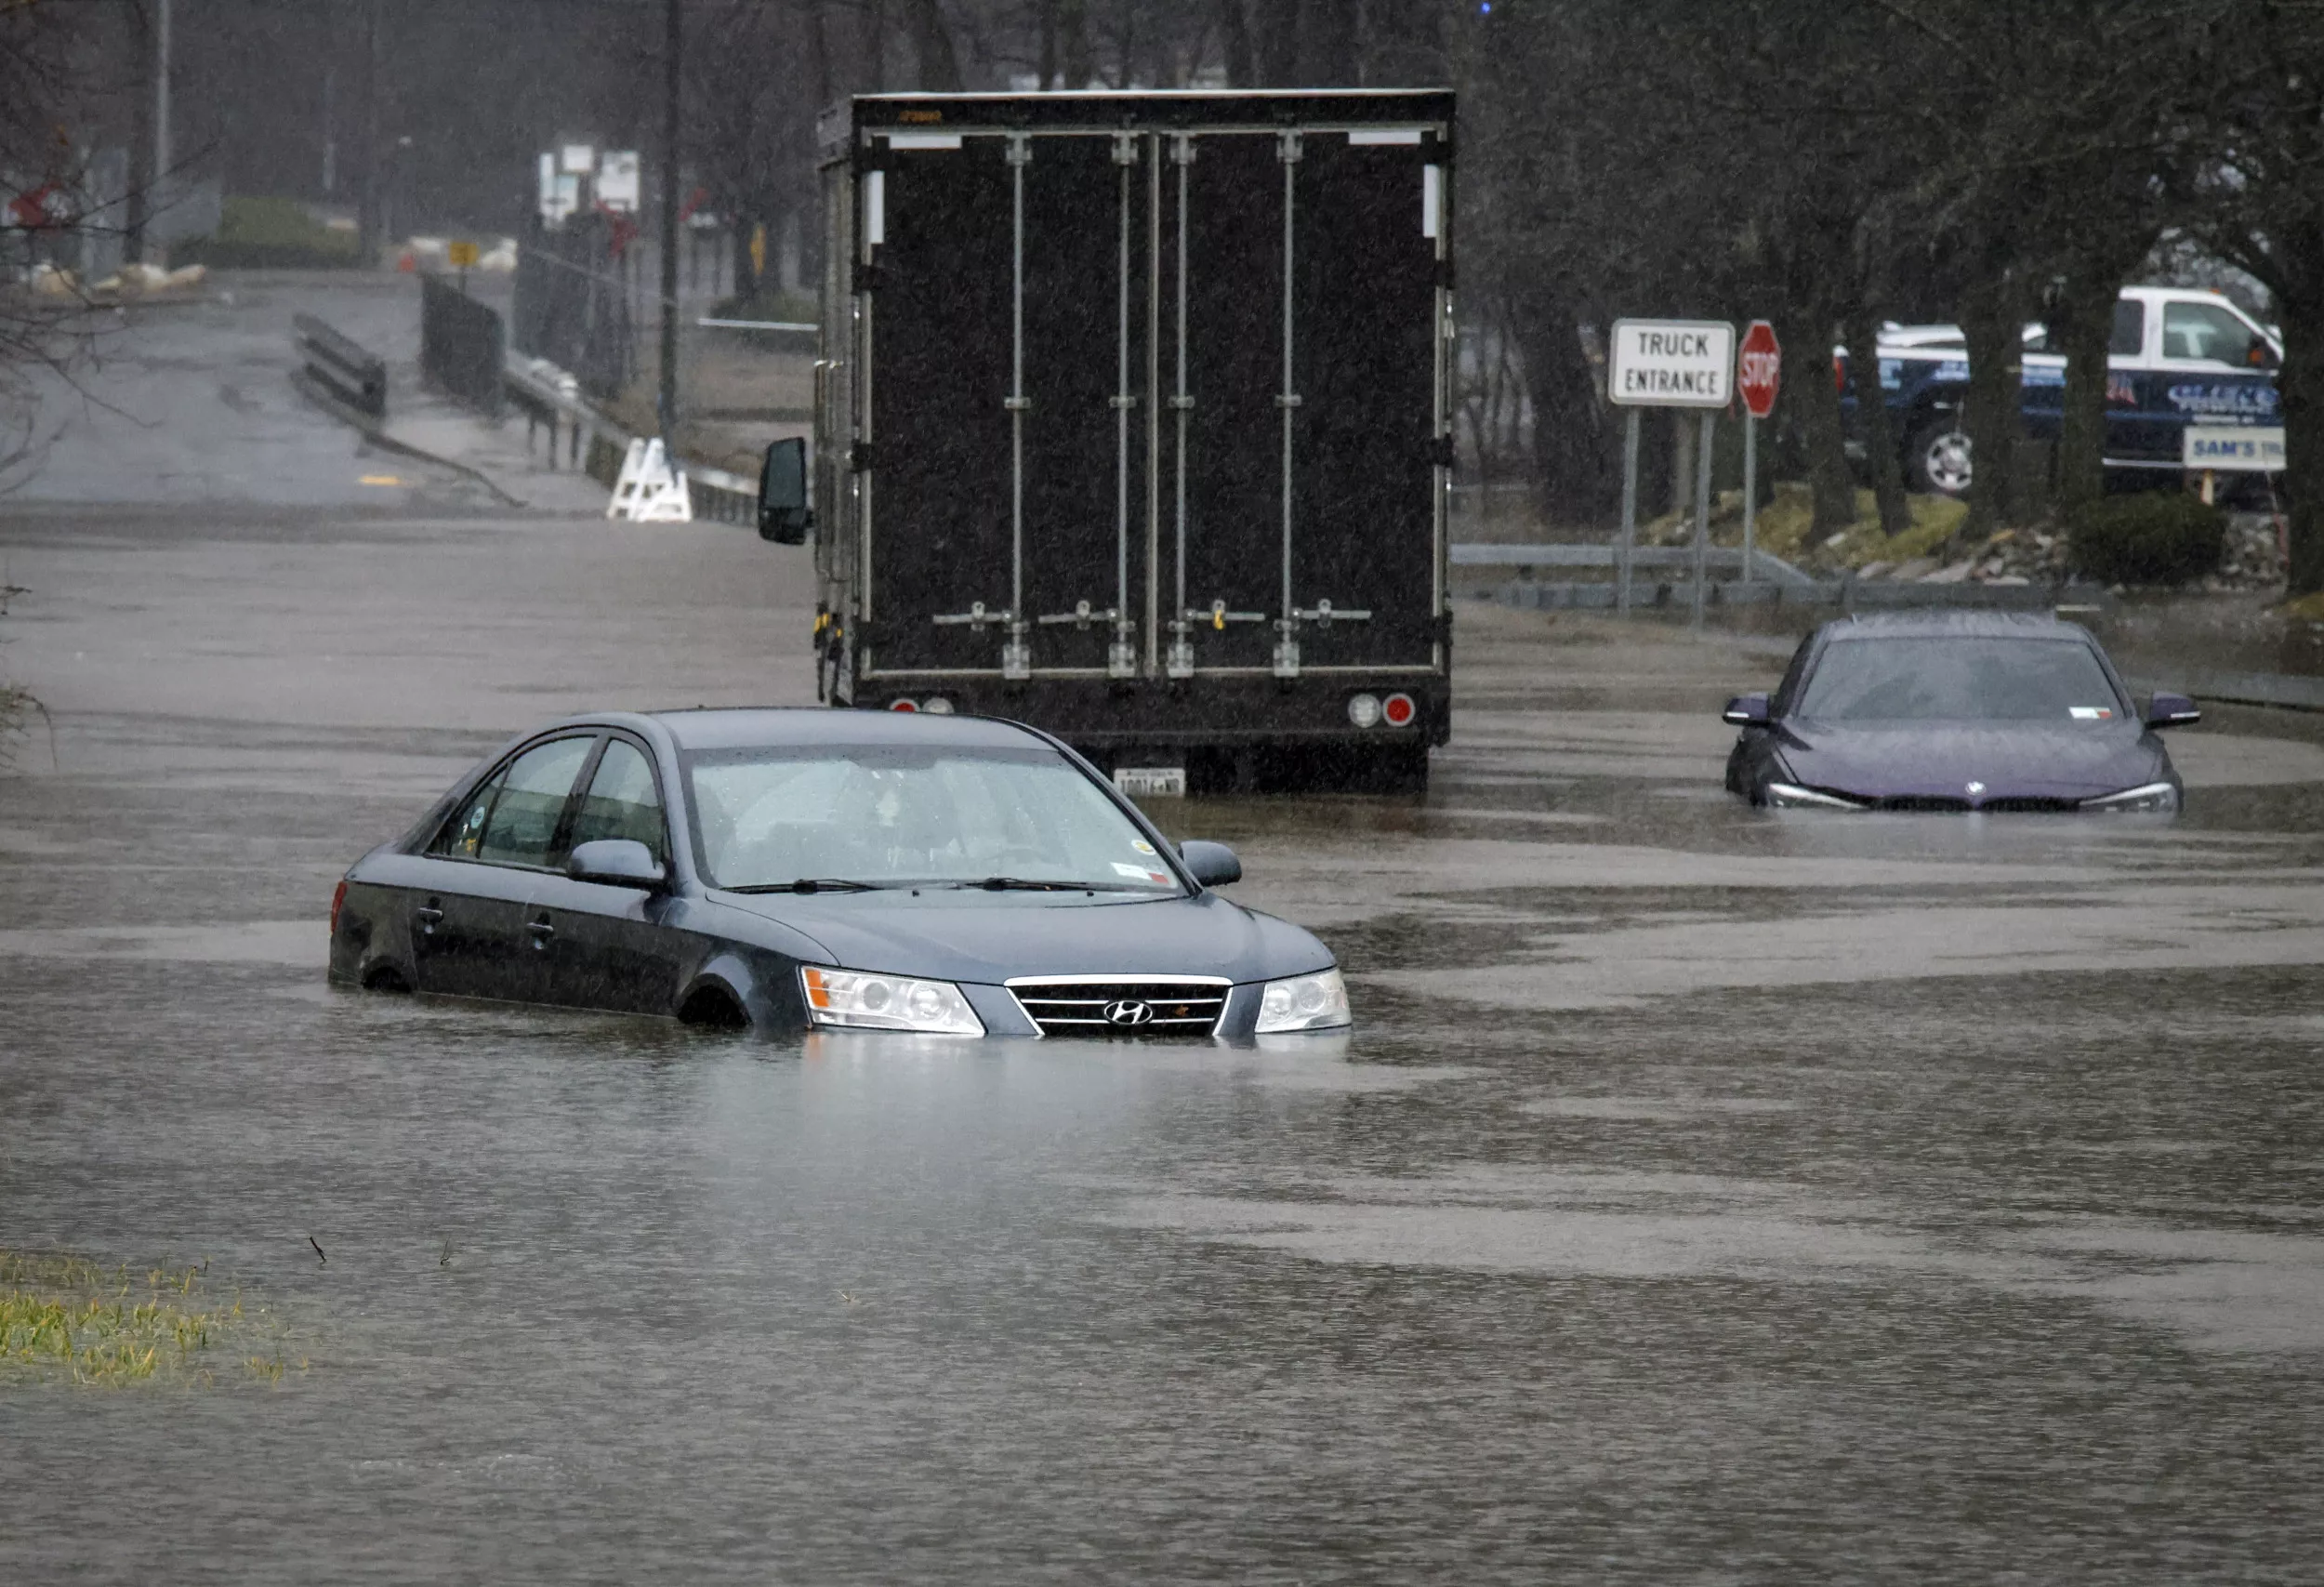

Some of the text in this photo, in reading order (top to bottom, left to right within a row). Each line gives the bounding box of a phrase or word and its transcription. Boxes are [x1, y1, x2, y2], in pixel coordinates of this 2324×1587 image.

[1638, 332, 1710, 357] TRUCK
[1625, 368, 1719, 395] ENTRANCE
[1742, 351, 1779, 388] STOP
[2194, 439, 2255, 457] SAM'S
